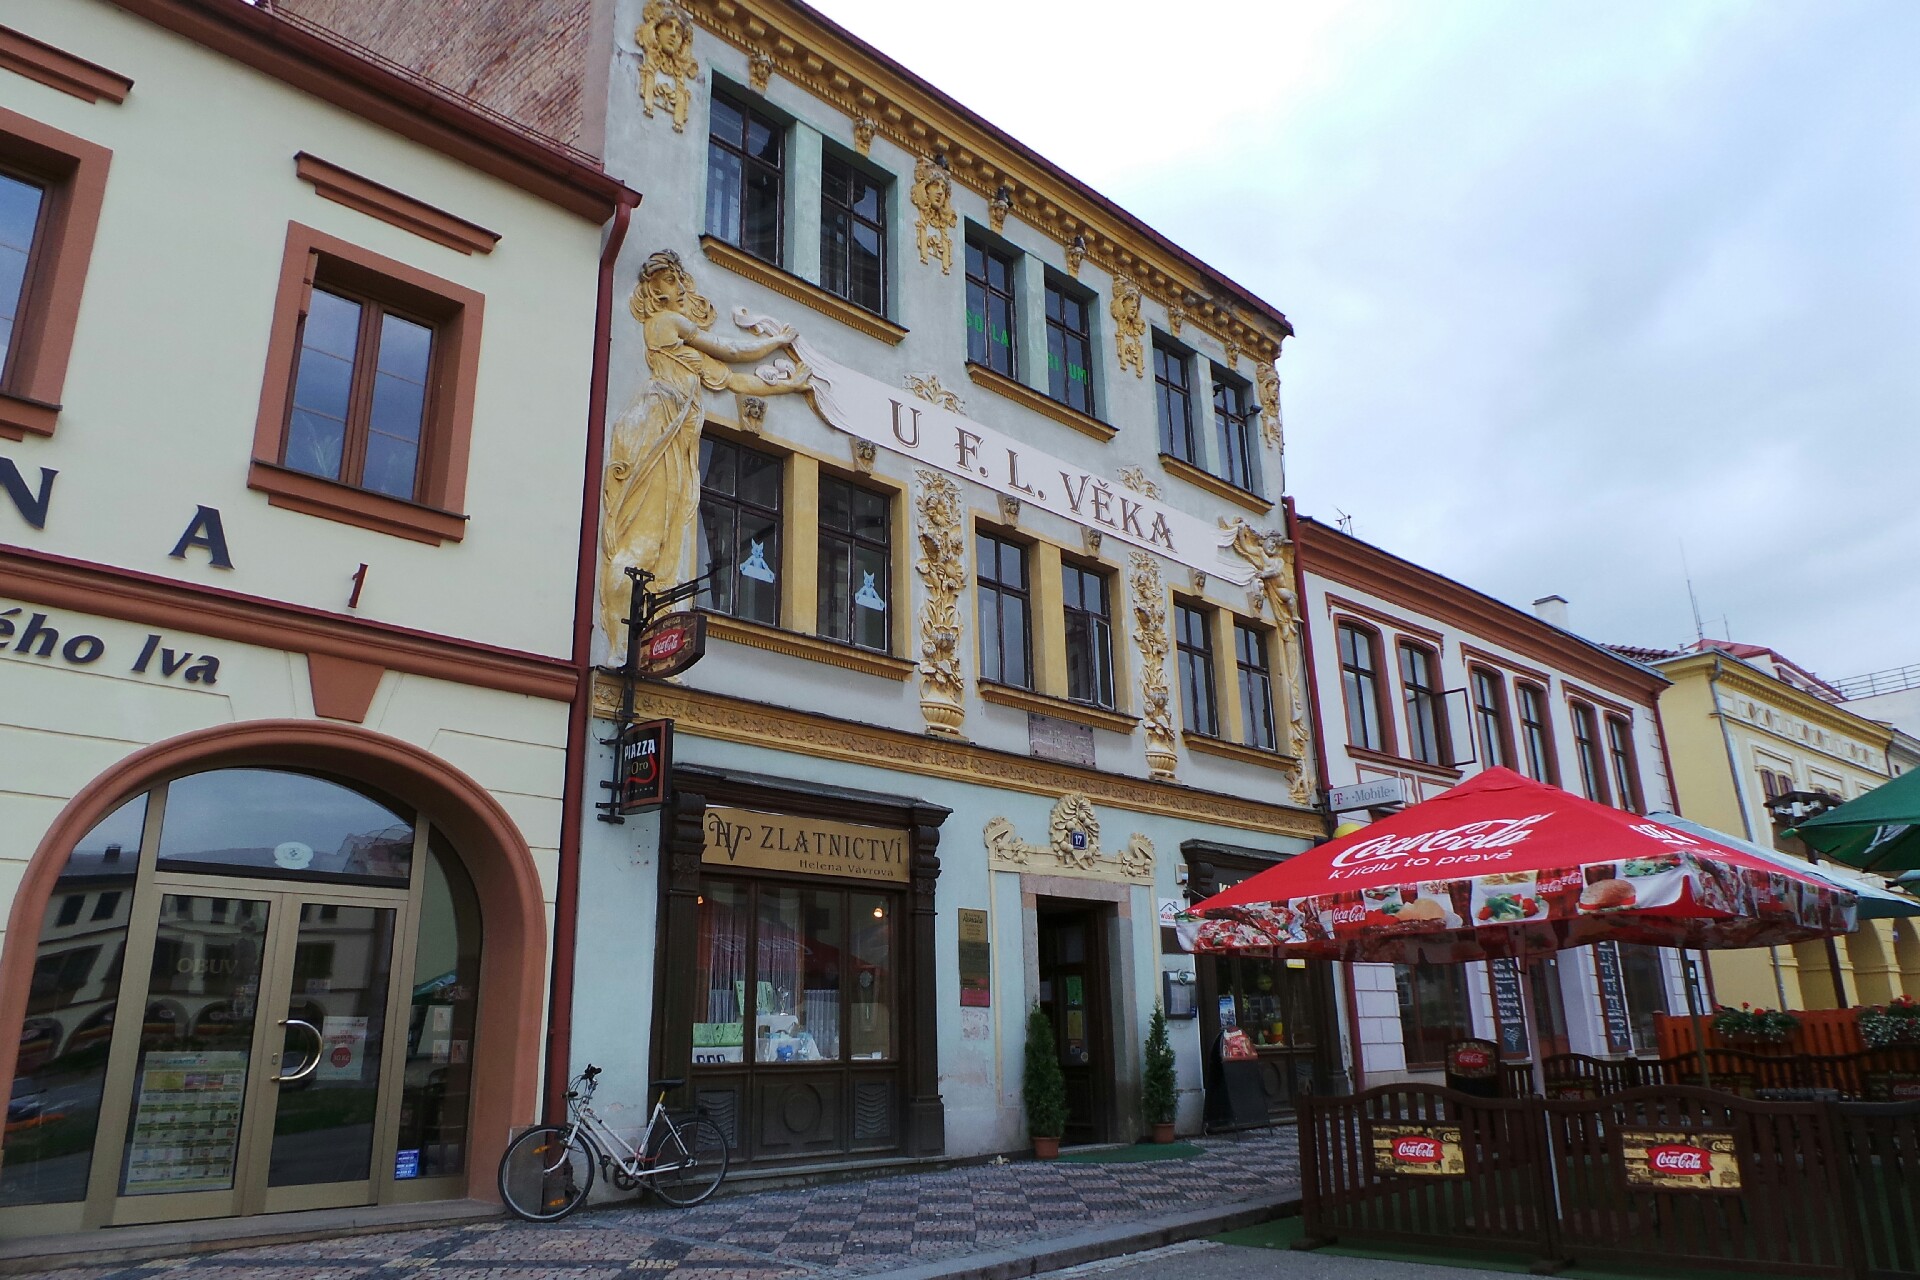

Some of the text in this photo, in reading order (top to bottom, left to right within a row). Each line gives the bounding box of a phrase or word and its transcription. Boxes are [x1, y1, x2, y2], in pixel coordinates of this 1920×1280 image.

[888, 398, 1180, 554] U F. L. VĚKA
[624, 739, 656, 761] PIAZZA
[760, 824, 903, 865] ZLATNICTVÍ
[1074, 834, 1083, 846] 17
[1332, 811, 1557, 868] Coca-Cola
[799, 859, 843, 873] Helena
[1328, 849, 1514, 880] k jídlu to pravé
